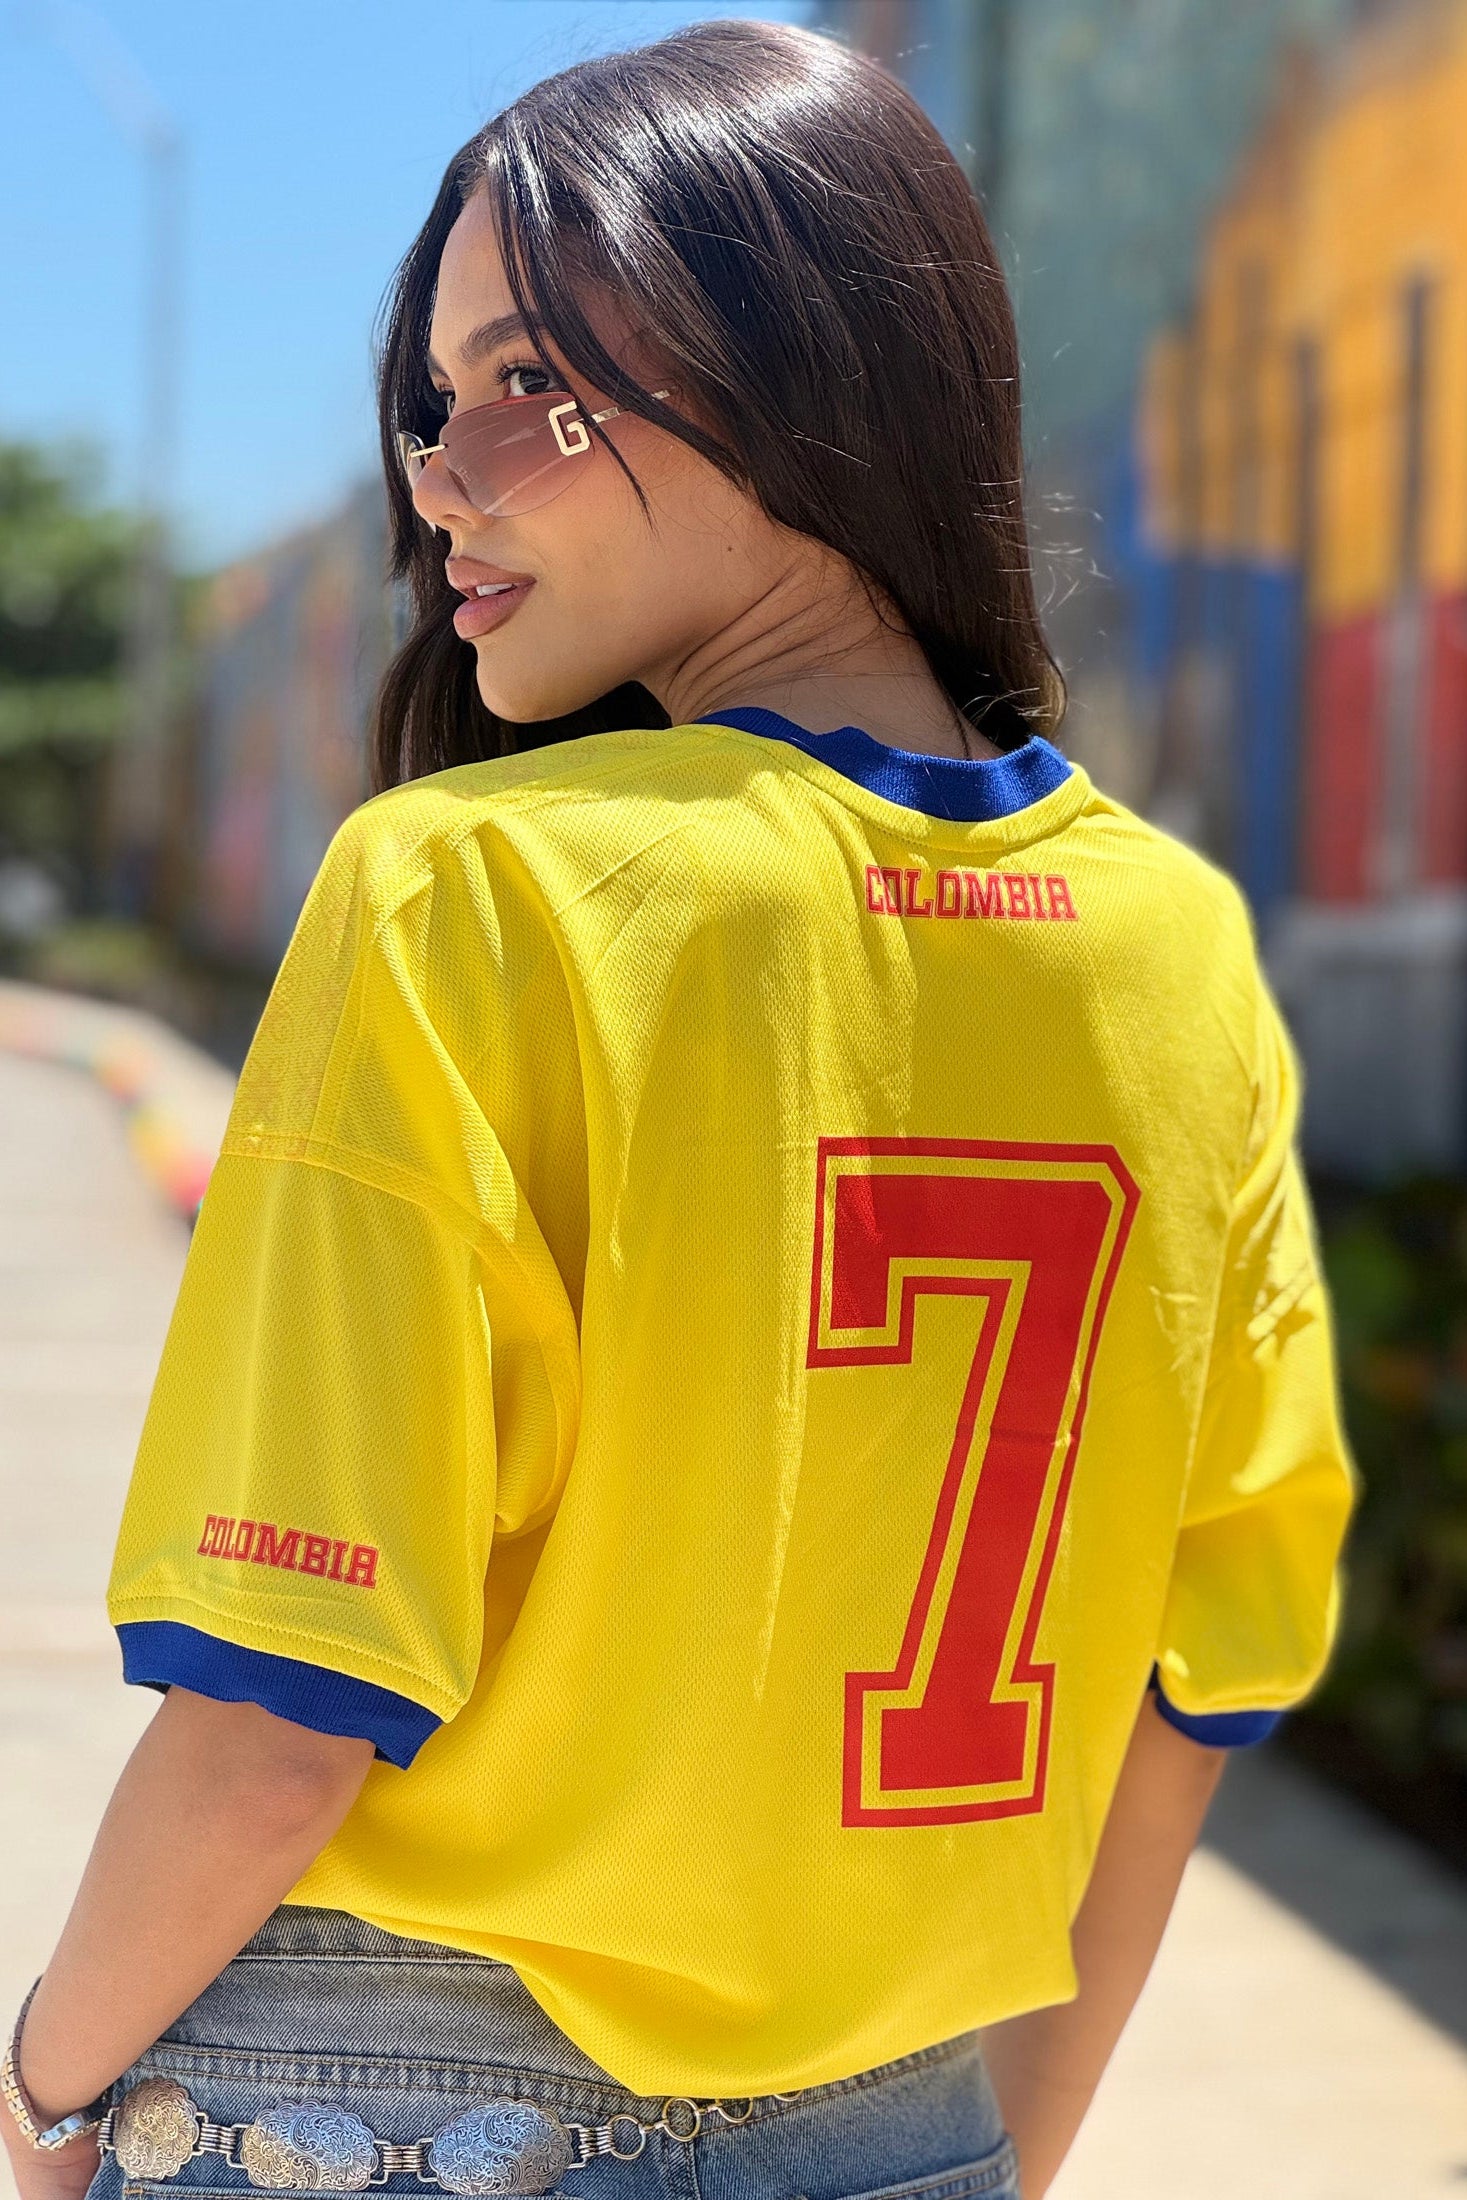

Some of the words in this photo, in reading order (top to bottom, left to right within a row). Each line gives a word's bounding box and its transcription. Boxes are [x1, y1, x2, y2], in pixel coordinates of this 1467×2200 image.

[865, 864, 1079, 921] COLOMBIA
[806, 1136, 1142, 1828] 7
[197, 1514, 379, 1589] COLOMBIA
